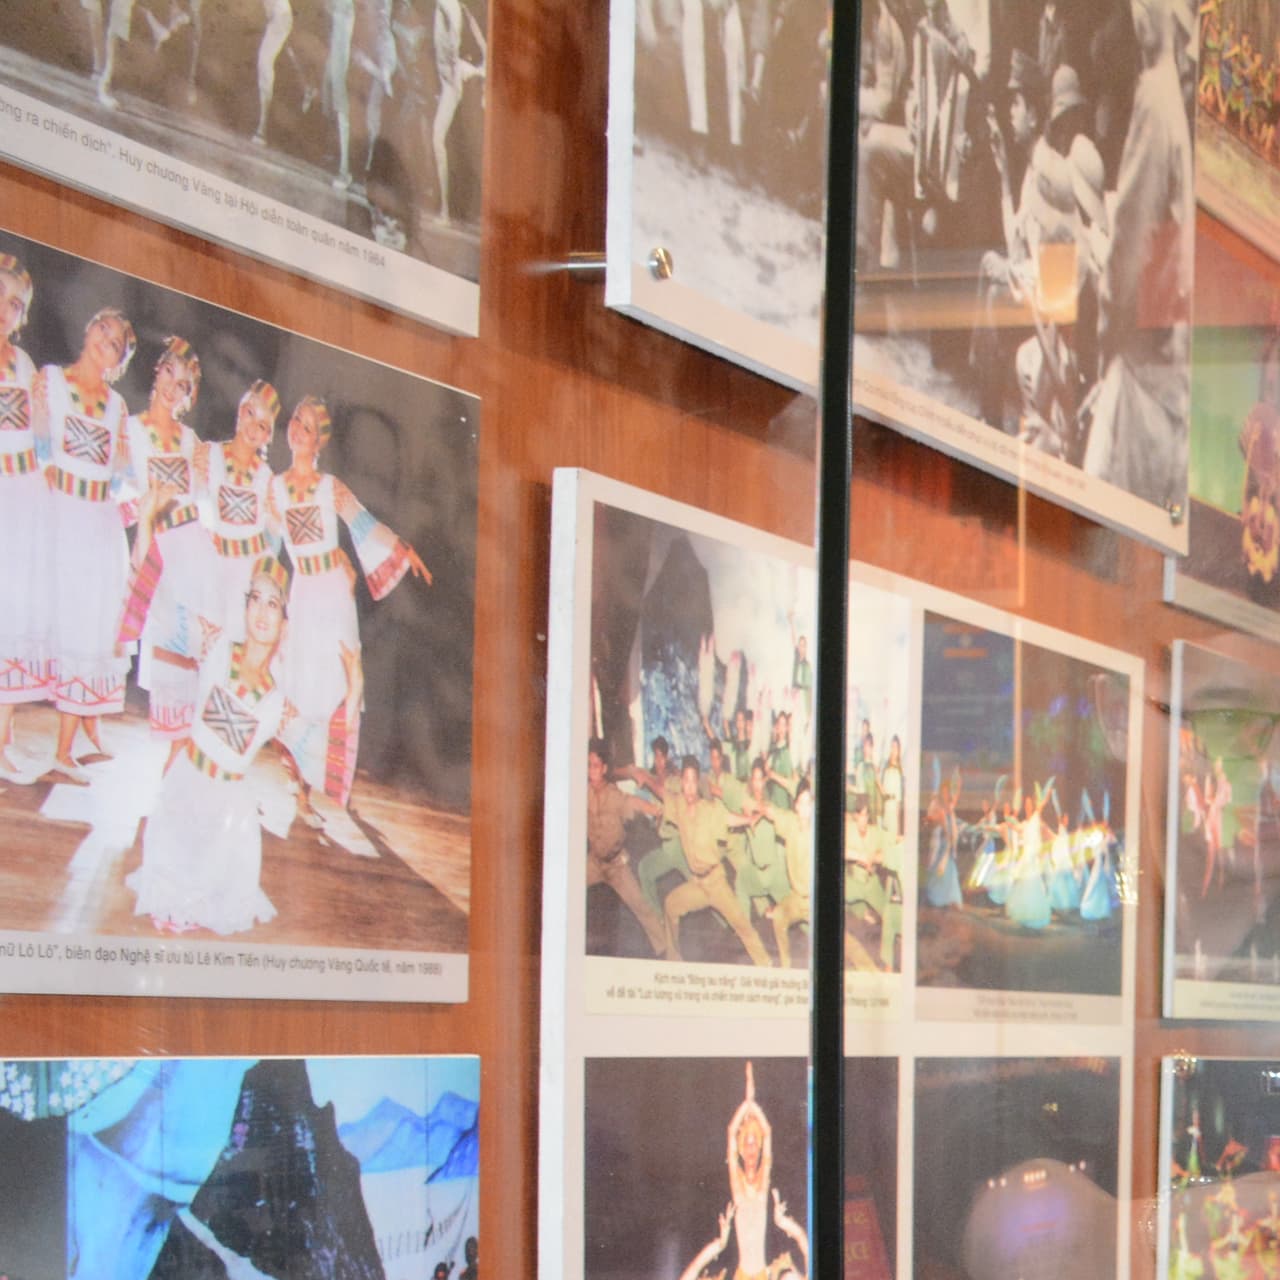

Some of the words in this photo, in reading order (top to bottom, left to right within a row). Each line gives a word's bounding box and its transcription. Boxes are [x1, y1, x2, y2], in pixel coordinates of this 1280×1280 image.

[26, 111, 40, 127] ra
[119, 147, 144, 171] Huy
[65, 945, 91, 960] biên
[95, 946, 117, 962] đạo
[120, 948, 151, 966] Nghệ
[214, 952, 235, 966] Kim
